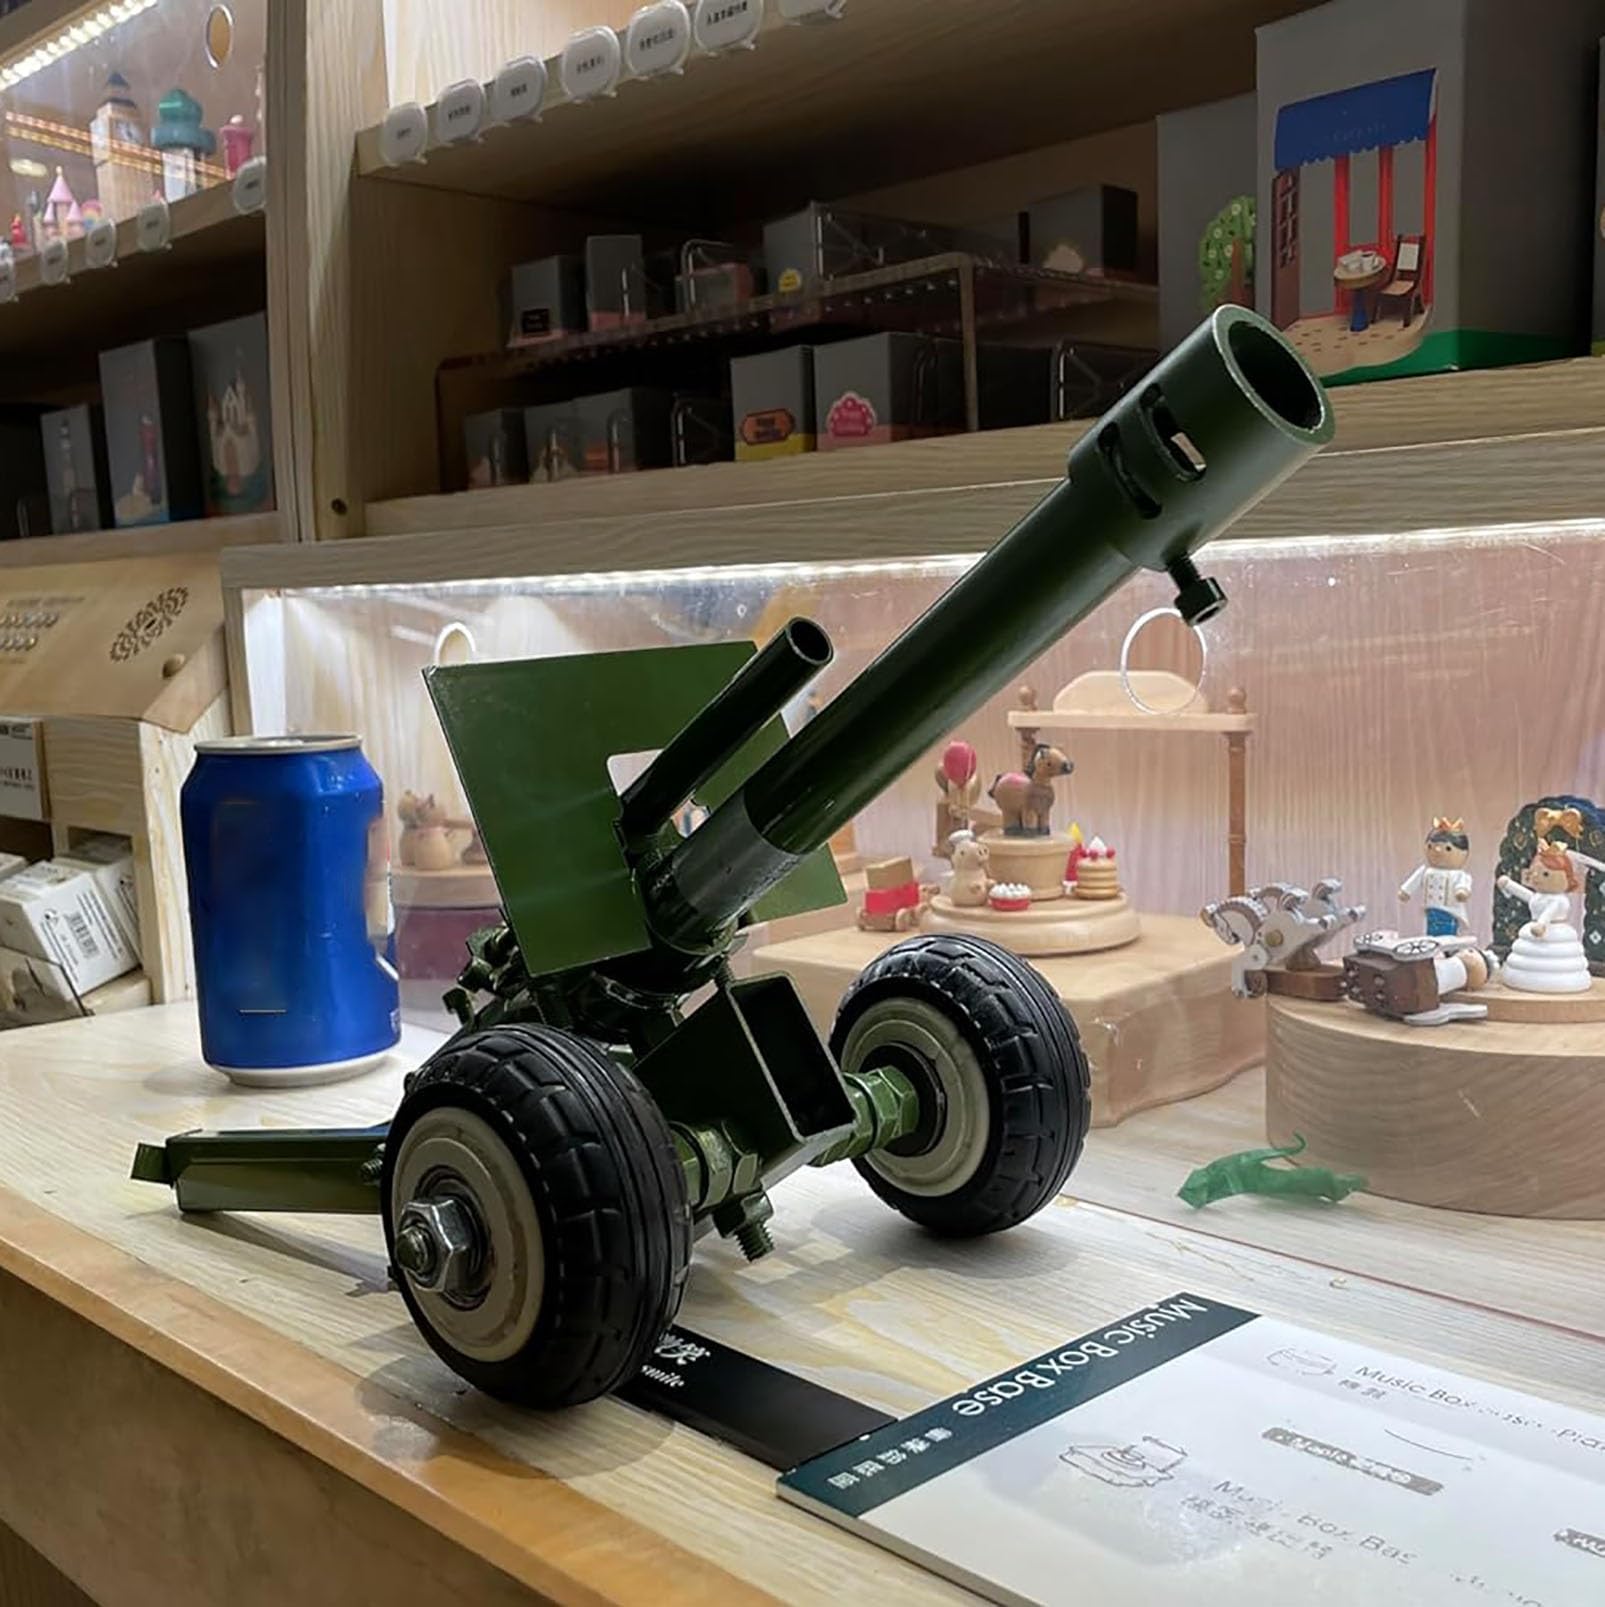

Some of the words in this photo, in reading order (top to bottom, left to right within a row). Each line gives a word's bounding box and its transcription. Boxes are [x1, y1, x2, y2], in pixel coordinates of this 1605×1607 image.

[1103, 1298, 1208, 1344] Music
[1036, 1341, 1120, 1376] Box
[952, 1370, 1055, 1416] Base
[1355, 1365, 1427, 1394] Music
[1429, 1388, 1478, 1408] Box
